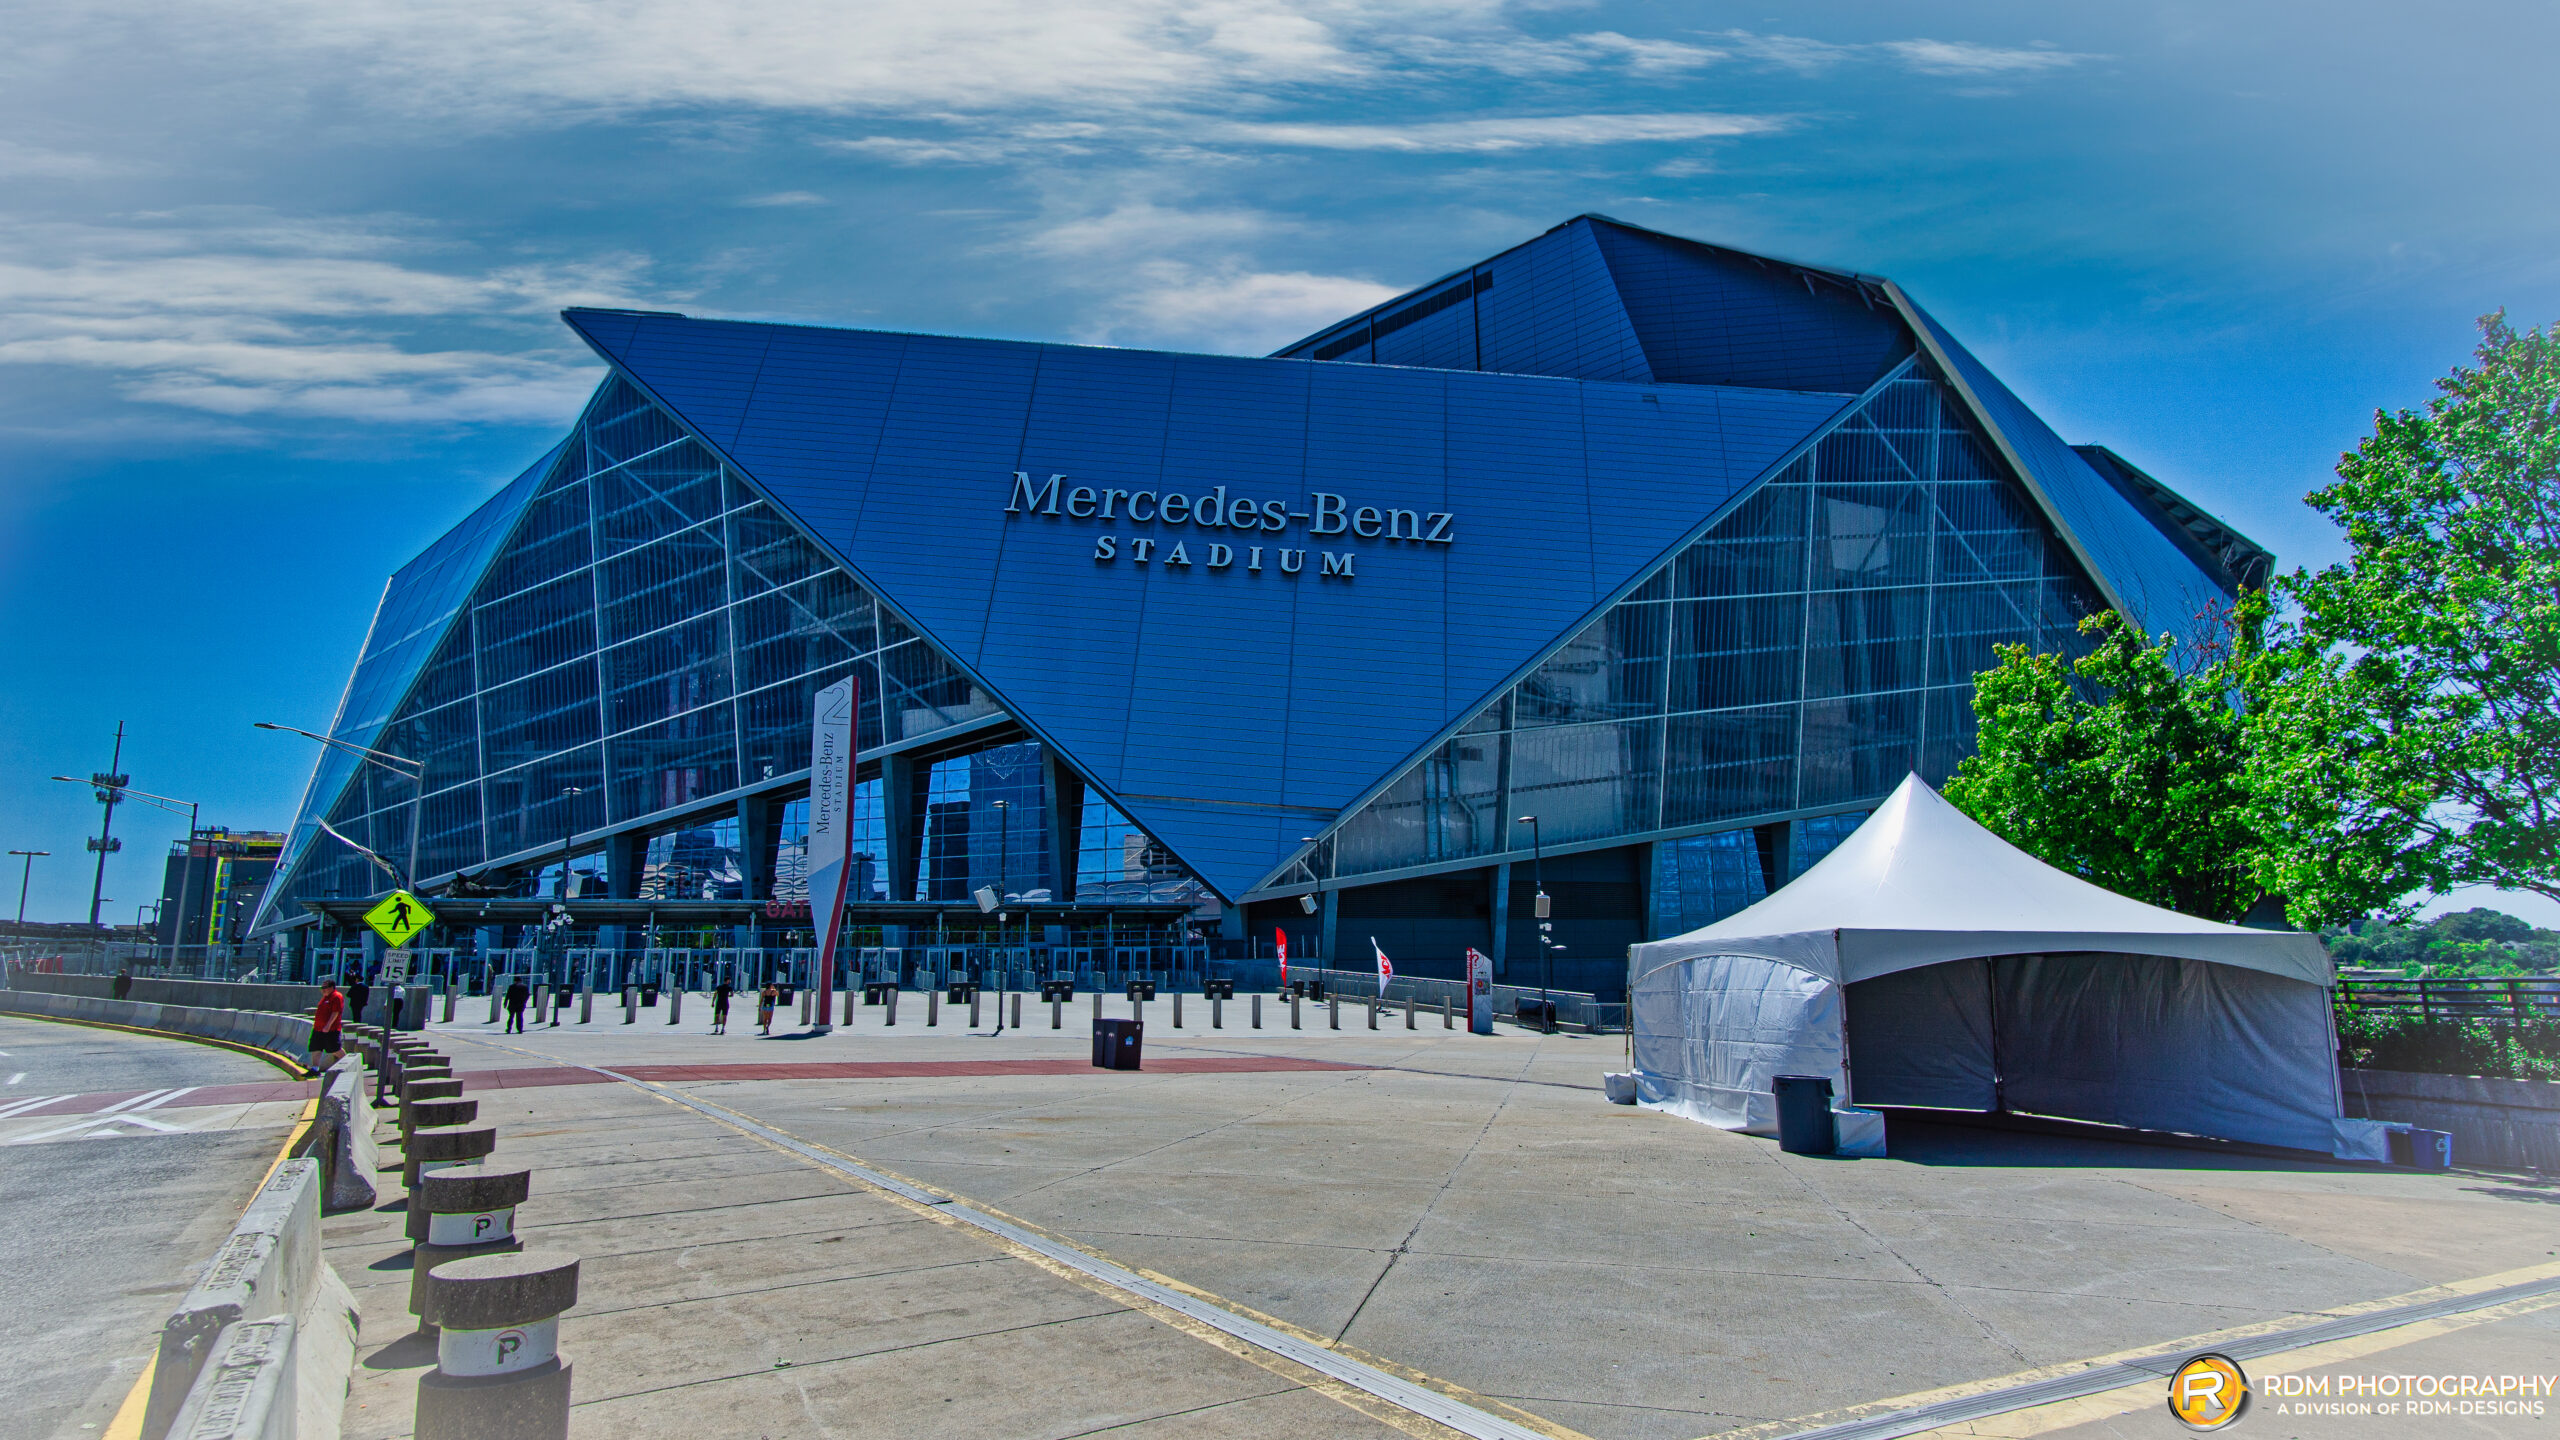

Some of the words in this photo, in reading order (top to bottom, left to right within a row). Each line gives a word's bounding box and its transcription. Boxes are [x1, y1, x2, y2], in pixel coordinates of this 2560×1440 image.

[1004, 471, 1455, 544] Mercedes-Benz
[1094, 535, 1356, 577] STADIUM
[822, 681, 851, 726] 2
[816, 732, 834, 835] Mercedes-Benz
[834, 755, 844, 813] STADIUM
[766, 900, 812, 918] GAT
[385, 966, 403, 979] 15
